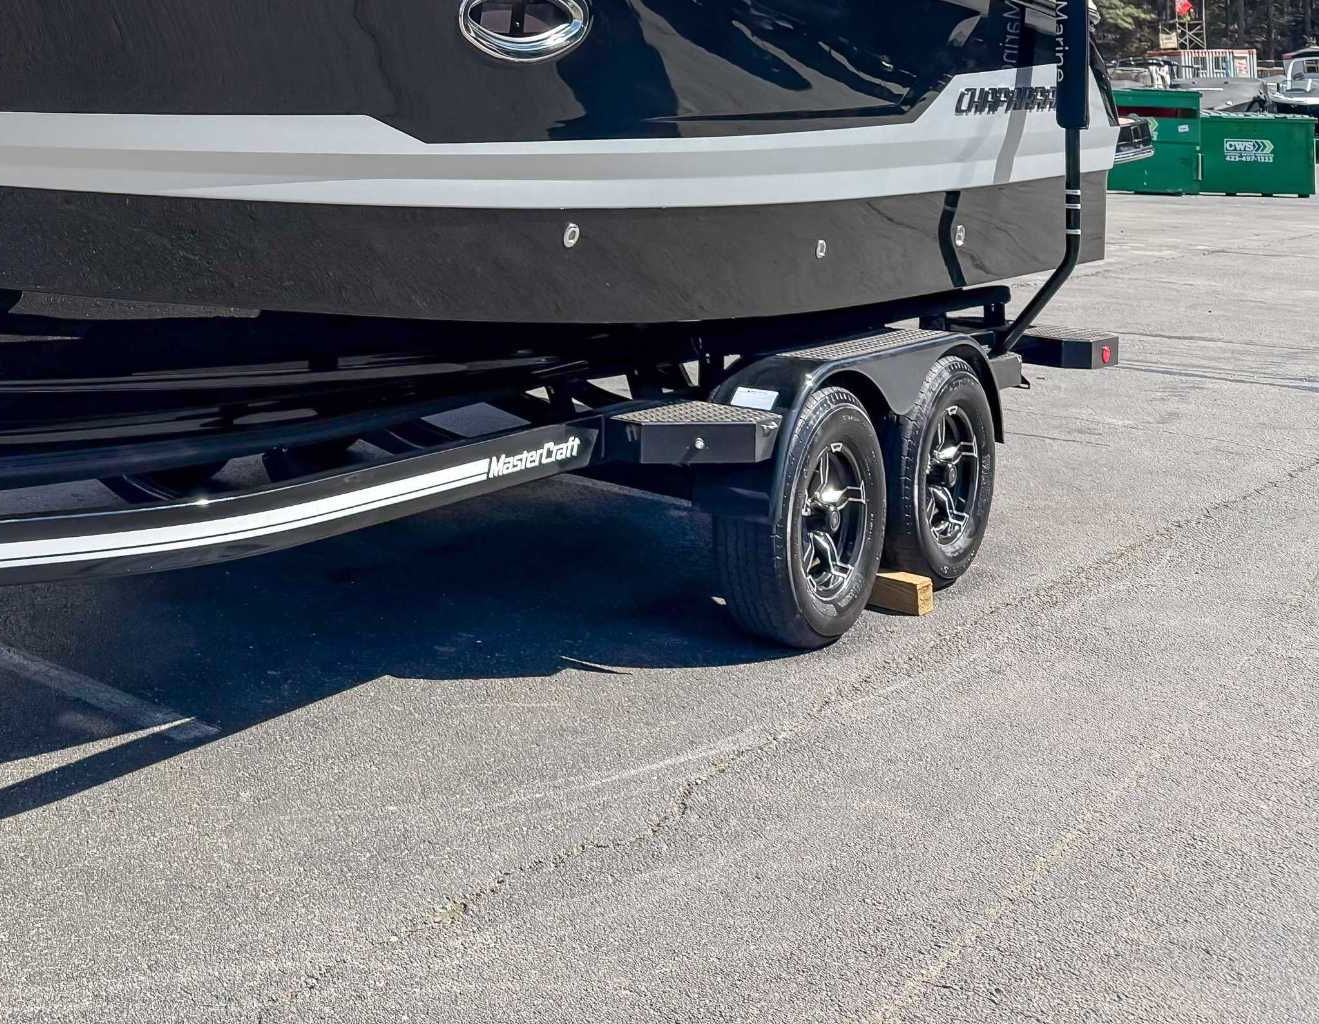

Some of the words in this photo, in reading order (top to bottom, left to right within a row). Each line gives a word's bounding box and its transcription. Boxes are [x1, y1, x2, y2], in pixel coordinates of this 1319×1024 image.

[1055, 1, 1069, 82] Marine
[955, 86, 1057, 116] CHAPARRA
[1226, 141, 1254, 152] CWS
[488, 436, 581, 479] MasterCraft
